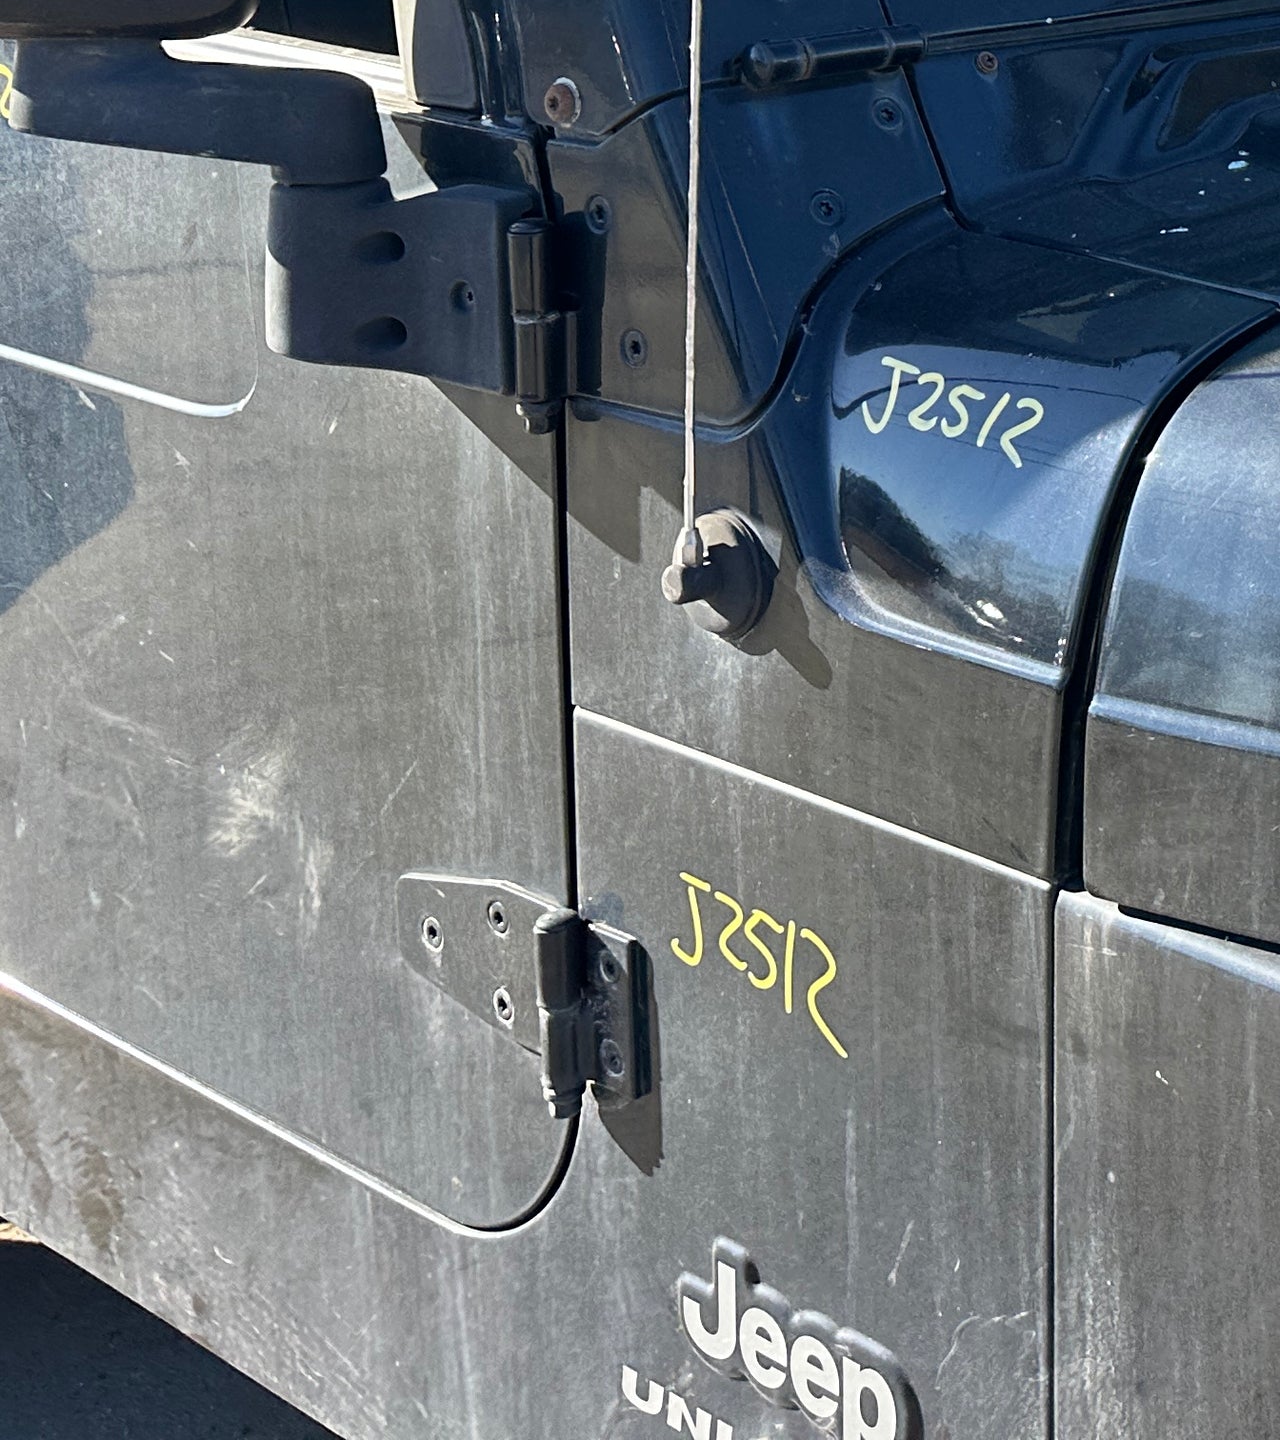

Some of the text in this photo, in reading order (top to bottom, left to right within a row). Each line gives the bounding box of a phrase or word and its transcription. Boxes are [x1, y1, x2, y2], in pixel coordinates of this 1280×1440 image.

[861, 356, 1045, 468] J2512
[671, 872, 848, 1059] J2512
[683, 1261, 897, 1440] Jeep
